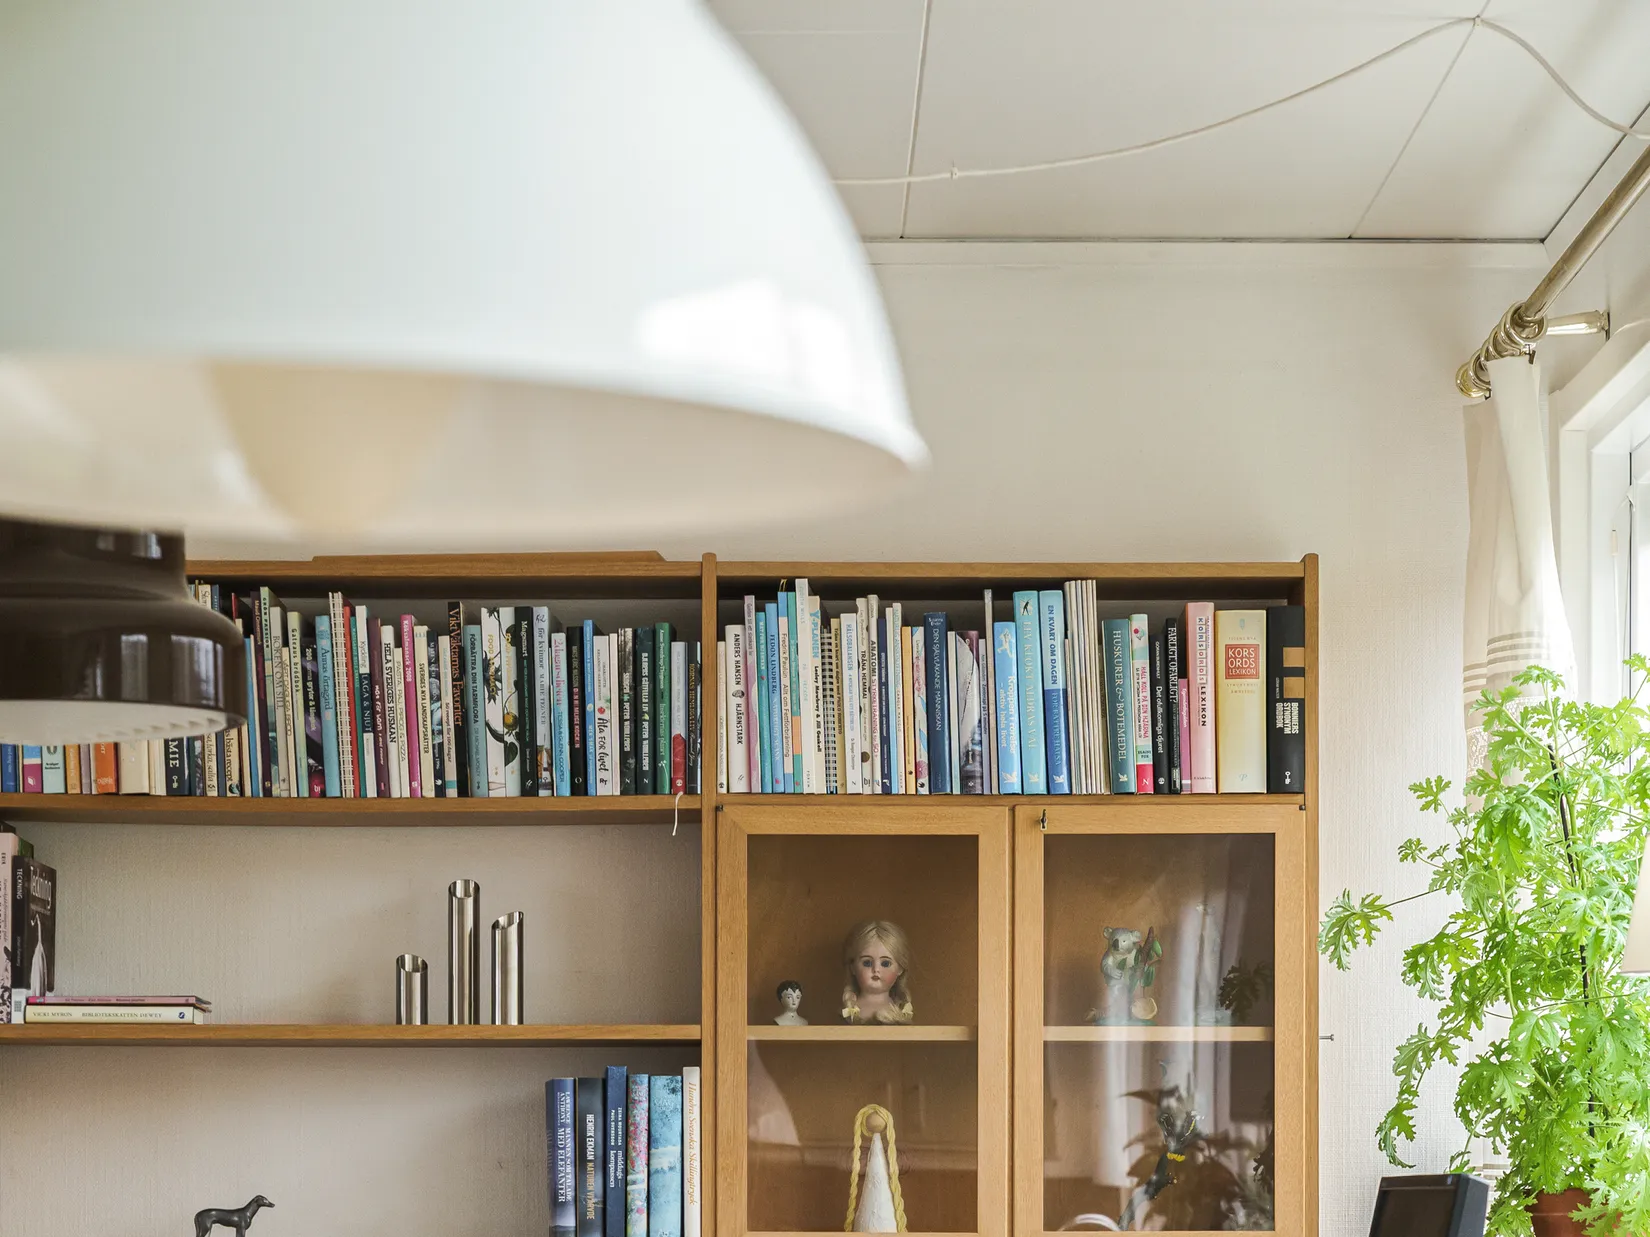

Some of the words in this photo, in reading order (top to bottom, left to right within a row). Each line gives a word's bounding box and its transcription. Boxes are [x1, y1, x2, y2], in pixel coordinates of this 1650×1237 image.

[1048, 605, 1054, 615] EN
[291, 628, 299, 658] Gateaus
[403, 620, 411, 666] Köksalmanack
[449, 608, 461, 678] ViktVäktarnas
[521, 621, 529, 657] Magsmart
[809, 610, 820, 659] Y-PLANEN
[1022, 621, 1032, 640] LEV
[272, 635, 282, 669] BOKEN
[305, 648, 313, 661] 200
[321, 647, 331, 673] Annas
[359, 640, 367, 668] Kyckling
[384, 642, 392, 665] HELA
[470, 634, 478, 671] FÖRBÄTTRA
[846, 624, 855, 671] HÄLSOBALANSEN
[1023, 644, 1035, 679] KLOKT
[1049, 644, 1056, 657] OM
[1113, 630, 1123, 685] HUSKURER
[1228, 648, 1255, 658] KORS
[933, 644, 941, 689] SJÄLVLÄKANDE
[1228, 658, 1255, 668] ORDS
[275, 671, 283, 689] OM
[305, 681, 314, 701] grytor
[323, 675, 332, 710] örtagård
[361, 674, 370, 698] LAGA
[385, 666, 394, 704] SVERIGES
[1115, 687, 1125, 702] &
[1168, 662, 1178, 702] OFARLIGT?
[276, 691, 284, 710] SILL
[453, 681, 463, 726] Favoriter
[813, 685, 821, 712] Mowbray
[1007, 676, 1015, 714] Kroppen
[1142, 695, 1148, 703] PÅ
[387, 706, 396, 743] HUSMAN
[421, 702, 430, 754] LANDSKAPSRÄTTER
[597, 718, 608, 733] Äta
[735, 703, 744, 745] HJÄRNSTARK
[1116, 703, 1127, 761] BOTEMEDEL
[1291, 702, 1299, 734] BONNIERS
[225, 738, 236, 757] bästa
[658, 738, 666, 755] planet
[1009, 721, 1017, 754] rörelse
[1027, 728, 1037, 750] VÄL
[168, 741, 179, 767] MIE
[598, 752, 609, 772] livet
[224, 758, 234, 782] recept
[688, 1082, 697, 1115] Hundra
[557, 1128, 565, 1148] MED
[586, 1114, 594, 1137] HENRIK
[688, 1116, 696, 1150] Svenska
[586, 1138, 594, 1160] EKMAN
[586, 1162, 594, 1191] NATUREN
[609, 1150, 617, 1188] kompassen
[687, 1151, 697, 1205] Skillingtryck
